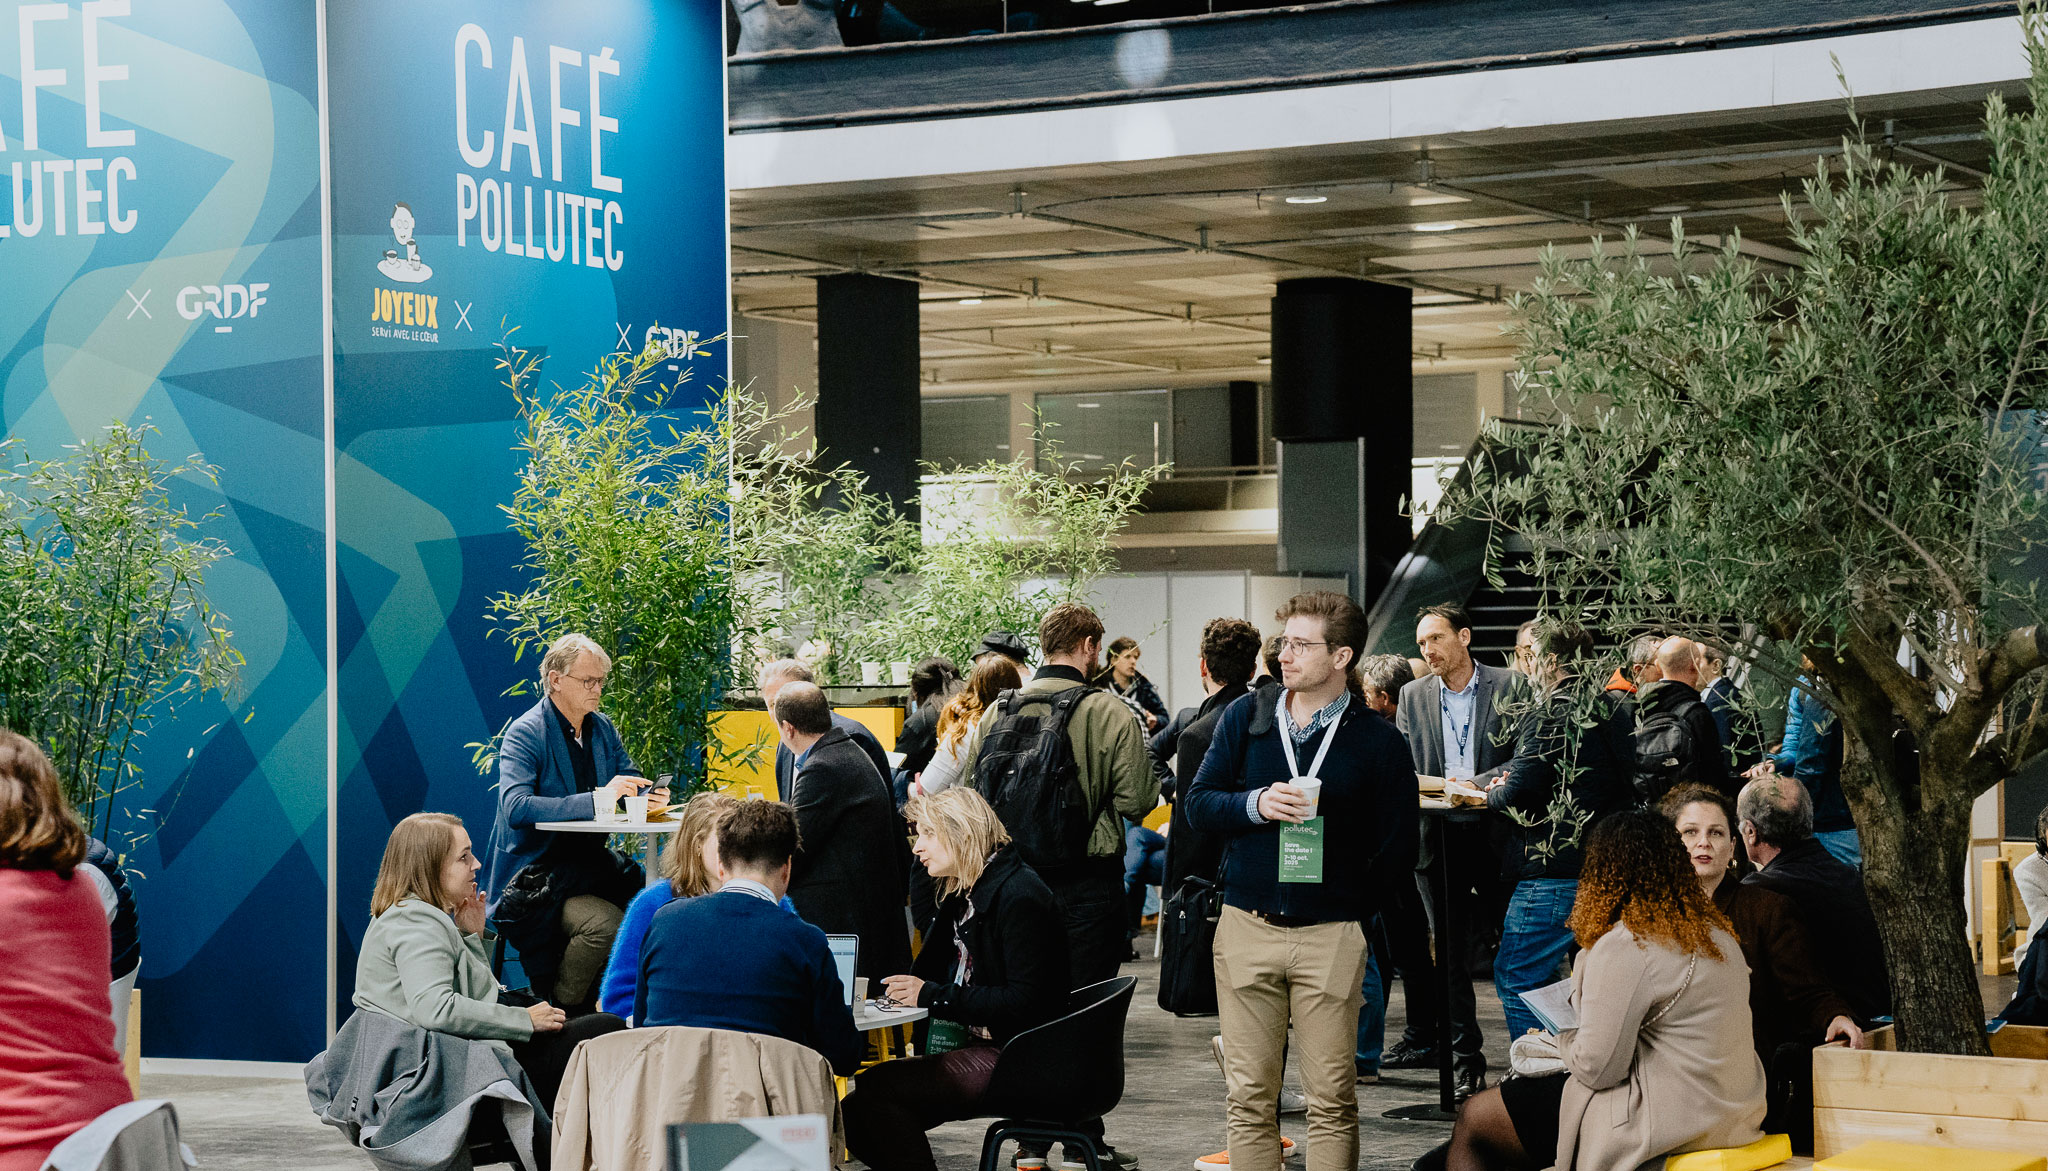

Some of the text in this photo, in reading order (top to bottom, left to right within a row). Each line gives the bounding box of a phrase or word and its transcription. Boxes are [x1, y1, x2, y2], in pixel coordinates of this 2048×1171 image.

[454, 23, 623, 194] CAFÉ
[0, 156, 138, 238] UTEC
[456, 172, 624, 272] POLLUTEC
[176, 283, 270, 321] GRDF
[371, 287, 439, 329] JOYEUX
[1284, 824, 1317, 835] pollutec
